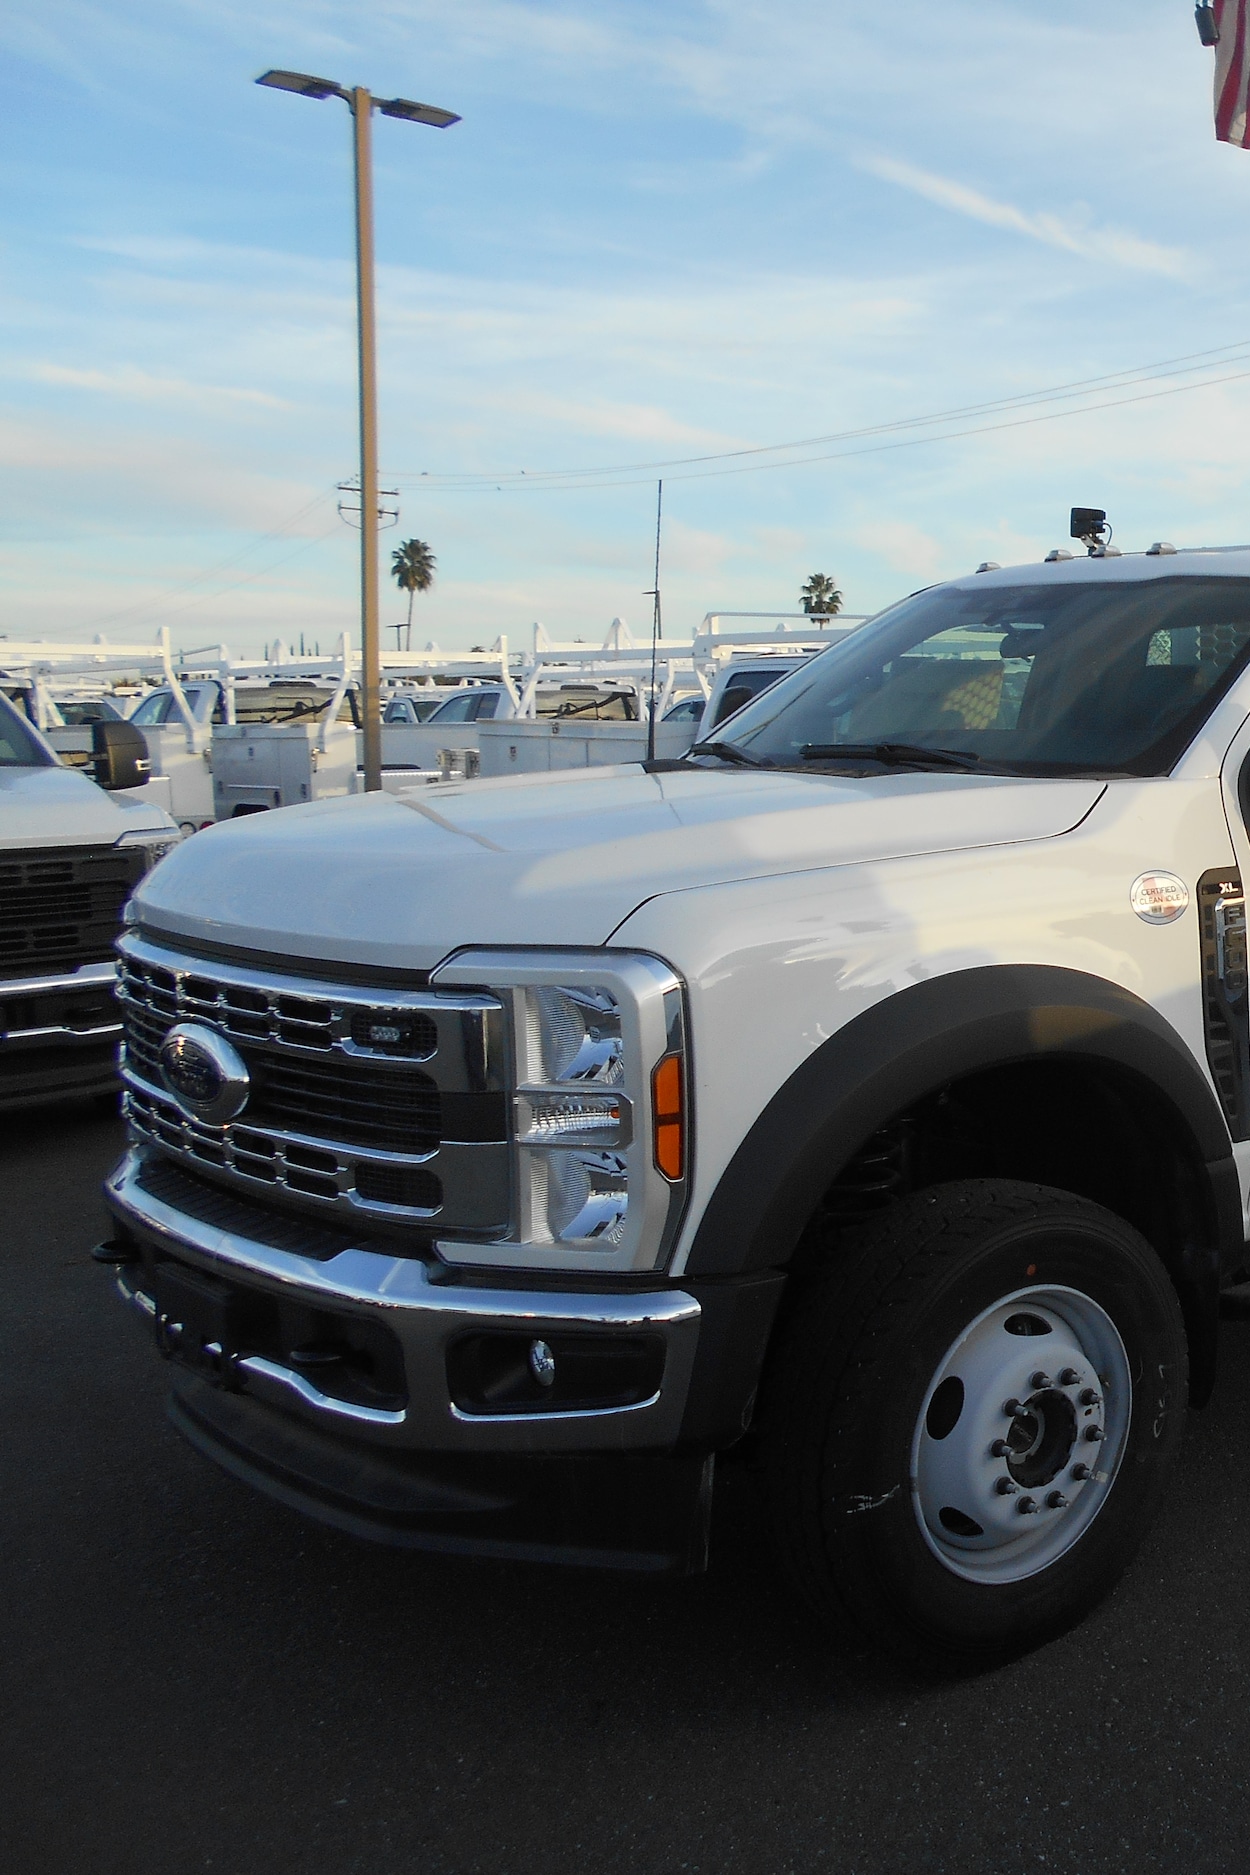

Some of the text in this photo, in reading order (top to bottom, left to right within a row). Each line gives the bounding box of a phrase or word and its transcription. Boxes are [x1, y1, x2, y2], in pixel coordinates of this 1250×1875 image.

[1141, 885, 1177, 896] CERTIFIED
[1219, 882, 1239, 894] XL
[1140, 896, 1164, 905] CLEAN
